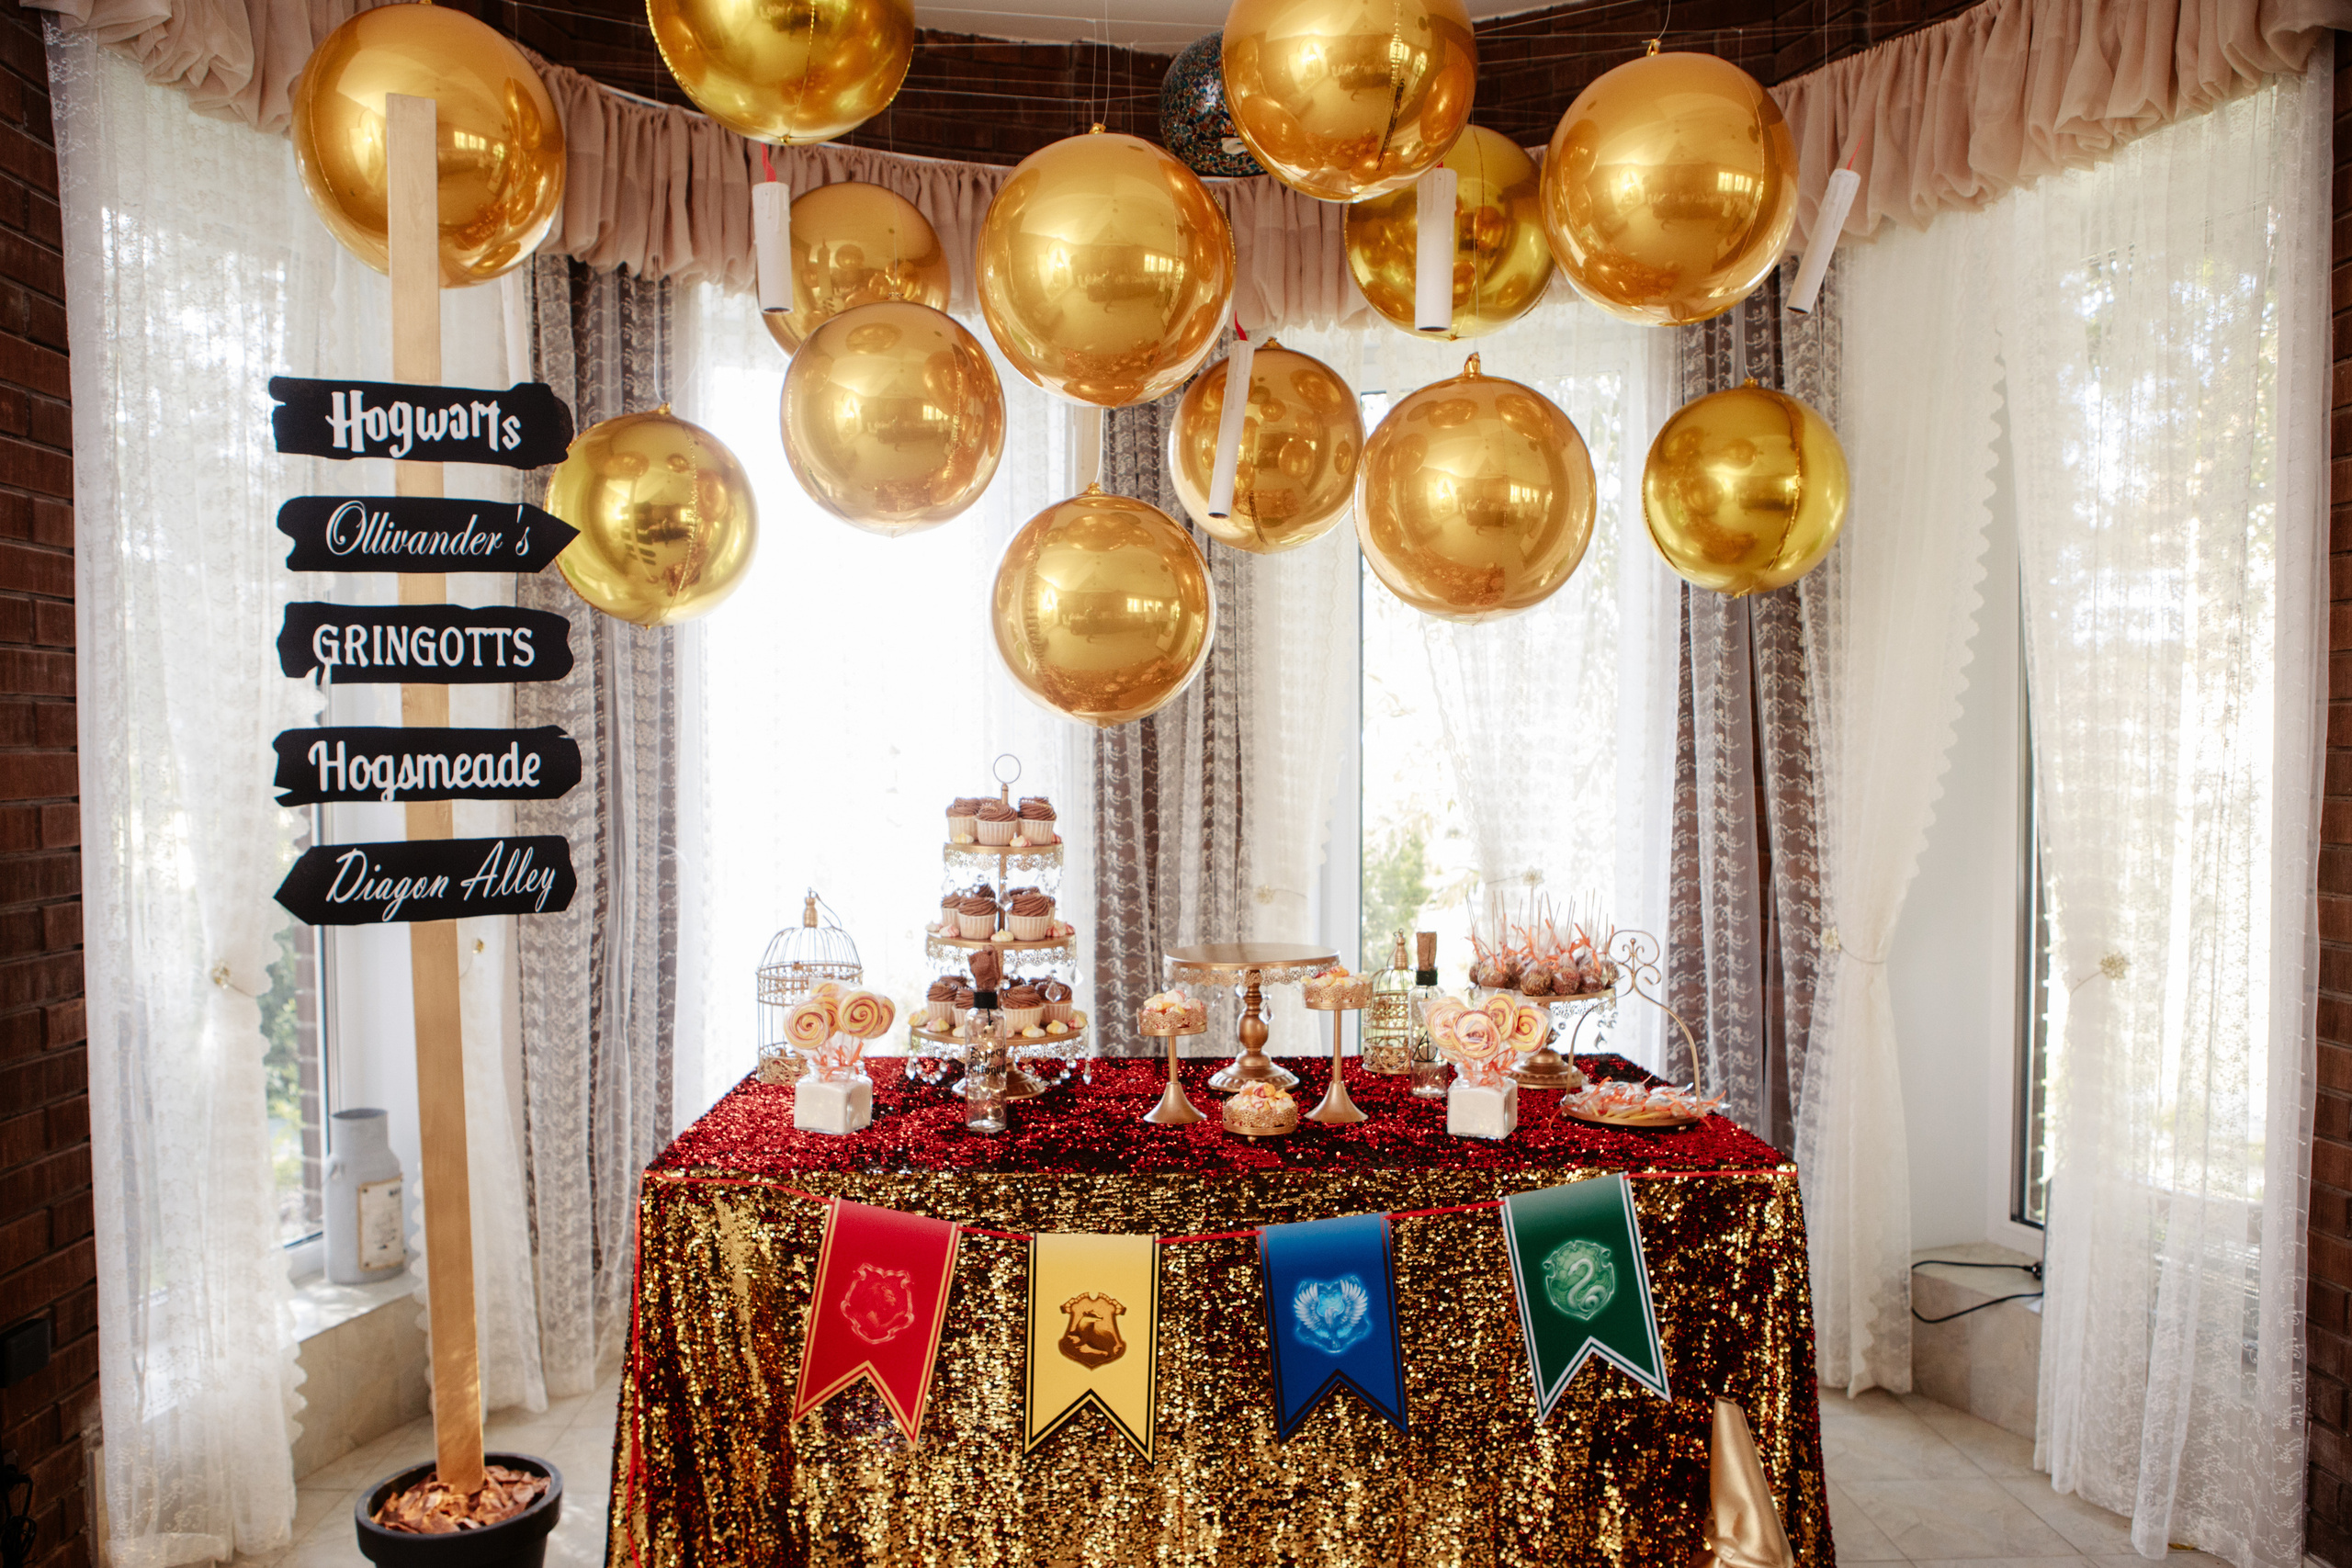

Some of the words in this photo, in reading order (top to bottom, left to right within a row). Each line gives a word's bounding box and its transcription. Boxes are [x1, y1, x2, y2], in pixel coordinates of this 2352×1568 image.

[324, 389, 521, 458] Hogwarts
[312, 624, 535, 667] GRINGOTTS
[308, 740, 541, 802] Hogsmeade
[325, 848, 449, 922] Diagon
[460, 840, 556, 912] Alley
